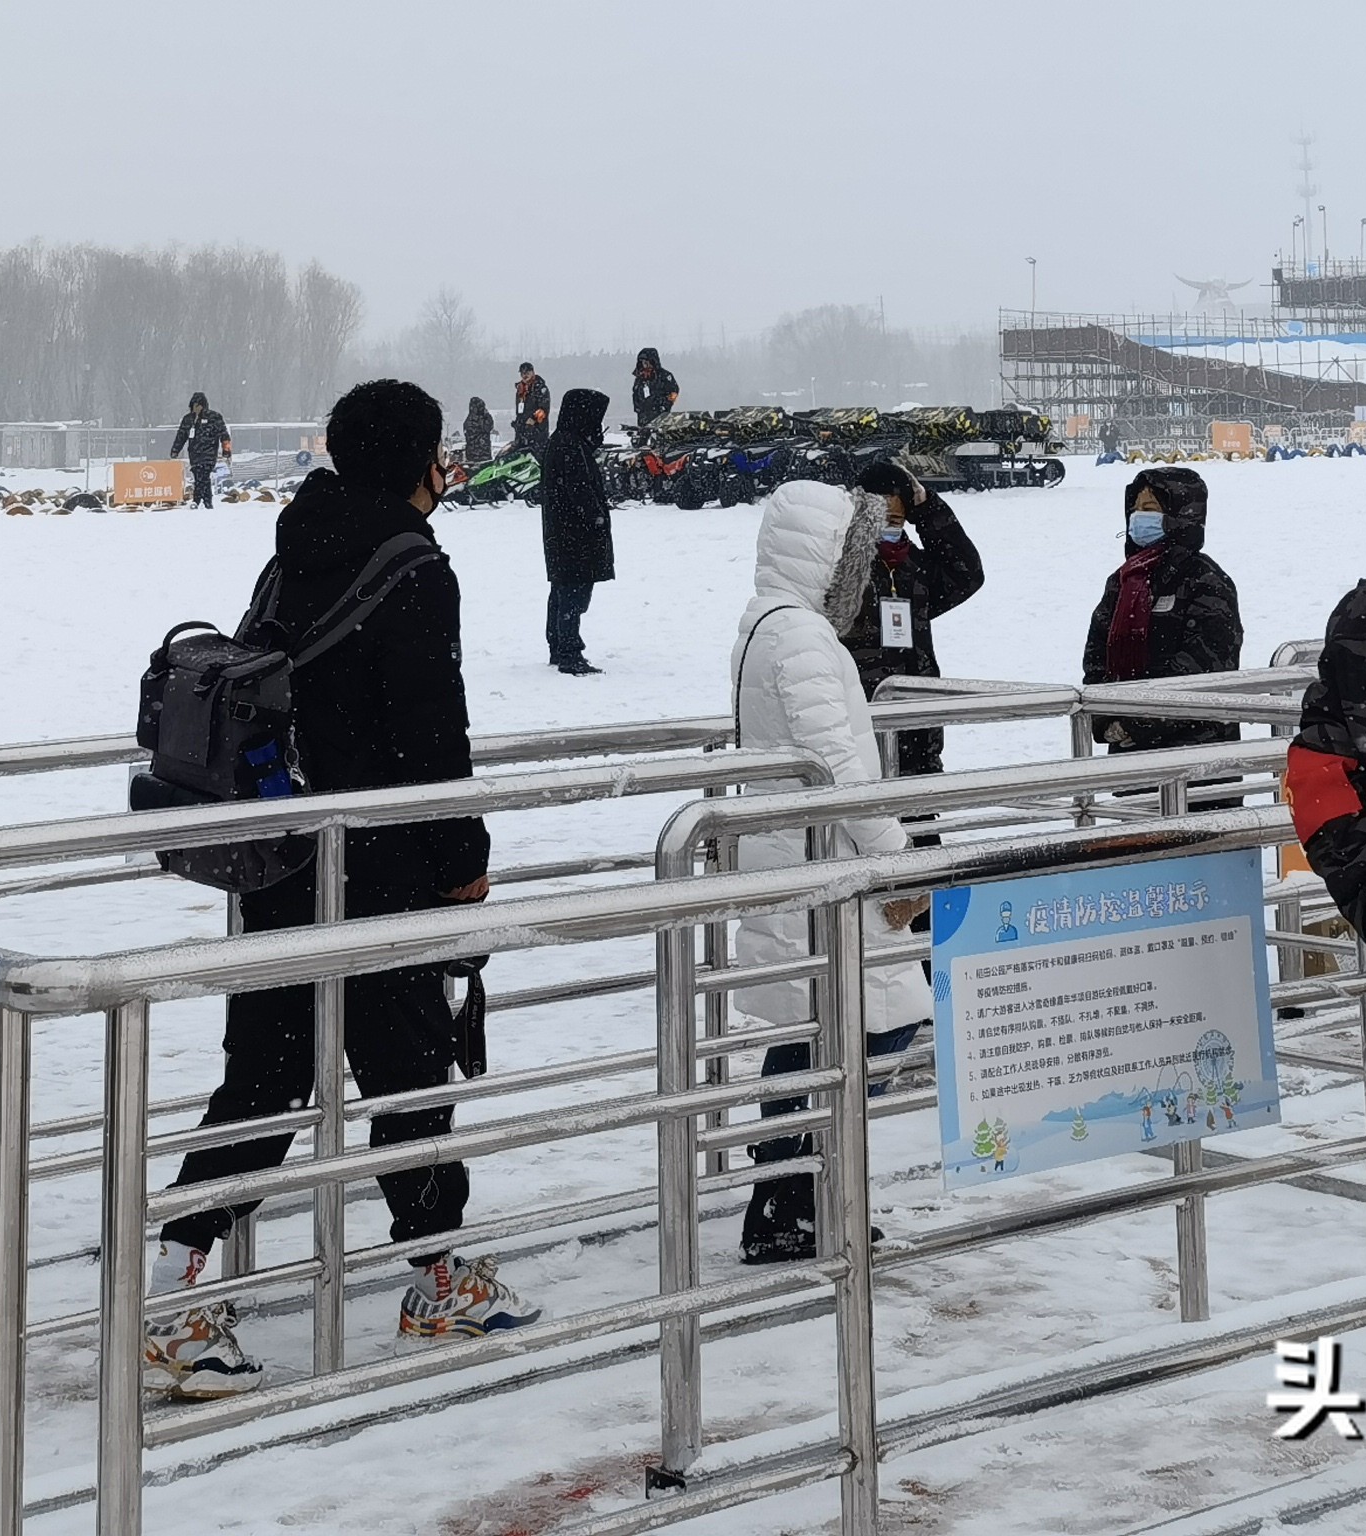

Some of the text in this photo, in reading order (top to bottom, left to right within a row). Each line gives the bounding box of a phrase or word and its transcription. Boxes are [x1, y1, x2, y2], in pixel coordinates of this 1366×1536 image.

[1026, 880, 1210, 934] 疫情防控温馨提示
